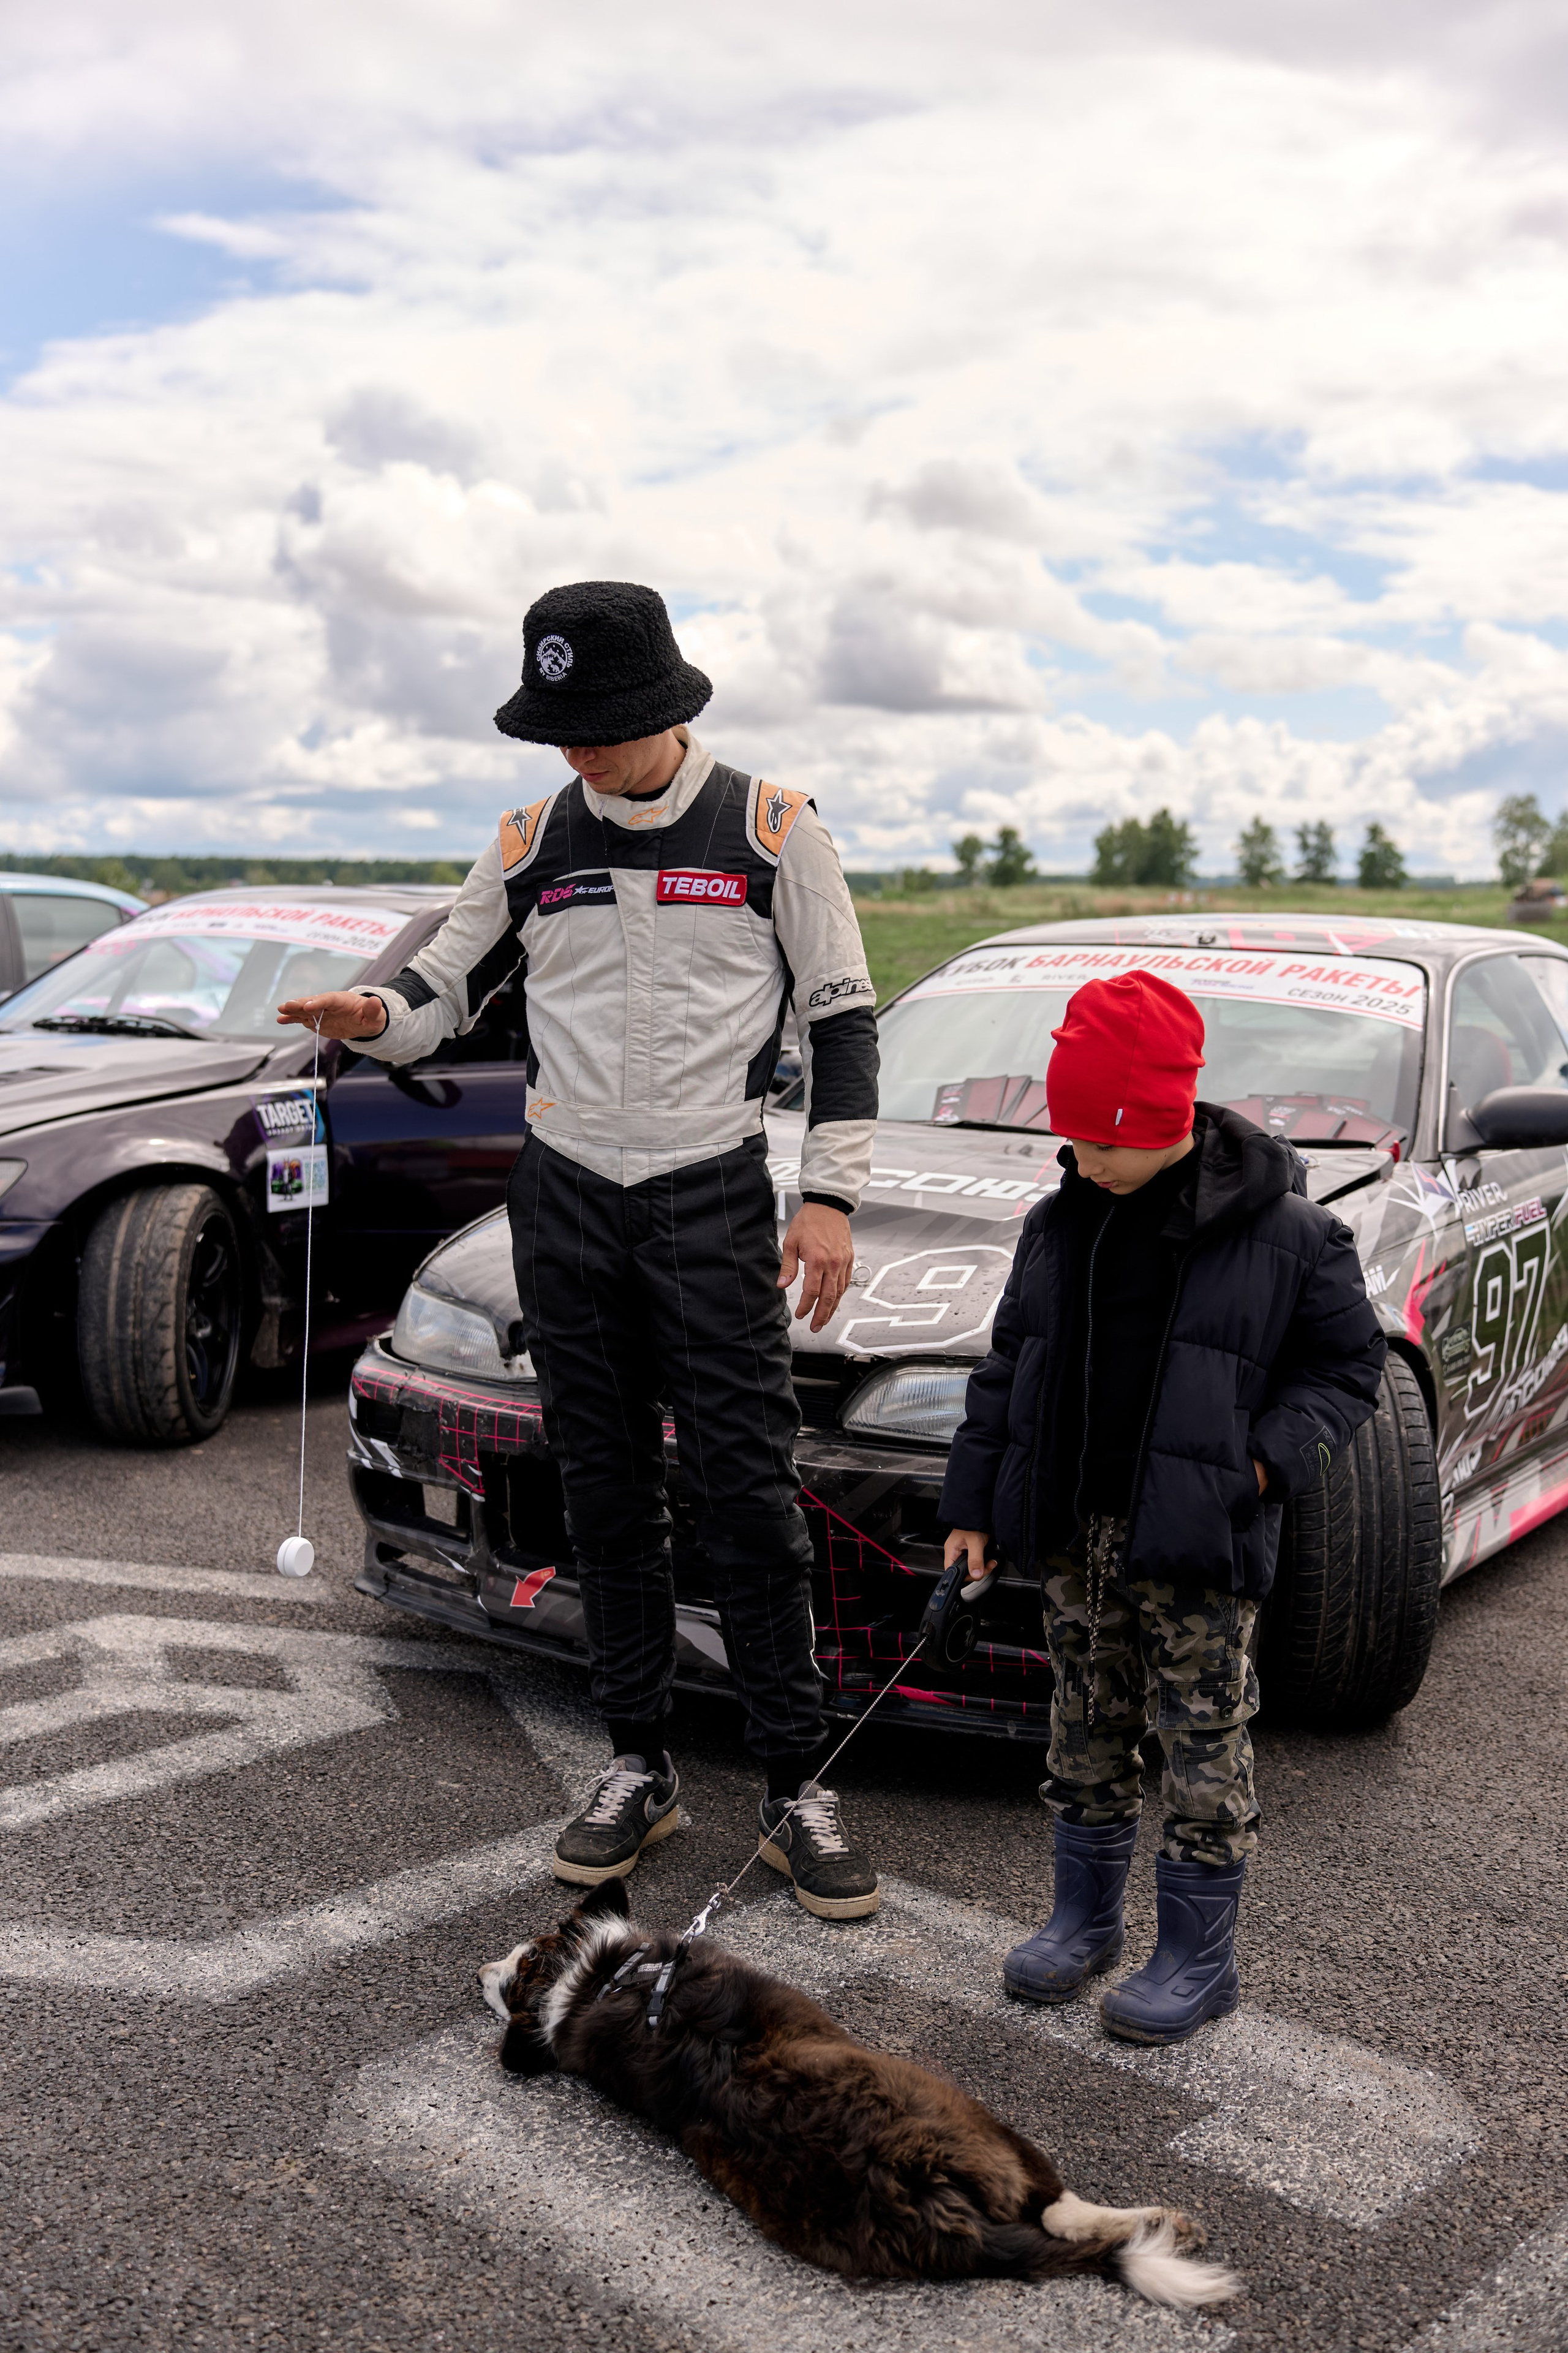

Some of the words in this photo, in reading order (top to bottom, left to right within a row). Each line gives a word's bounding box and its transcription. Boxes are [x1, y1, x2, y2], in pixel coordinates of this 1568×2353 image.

[537, 635, 565, 662] СИБИРСКИЙ
[564, 643, 573, 668] СТИЛЬ
[539, 667, 546, 676] MY
[546, 671, 568, 681] SIBERIA
[540, 883, 576, 905] RDS
[662, 877, 741, 899] TEBOIL
[310, 913, 399, 937] РАКЕТЫ
[342, 935, 383, 950] 2025
[1025, 953, 1276, 976] БАРНАУЛЬСКОЙ
[1278, 964, 1422, 998] РАКЕТЫ
[1287, 988, 1347, 1004] СЕЗОН
[1350, 995, 1414, 1015] 2025
[256, 1099, 314, 1130] TARGET
[1464, 1225, 1551, 1420] 97
